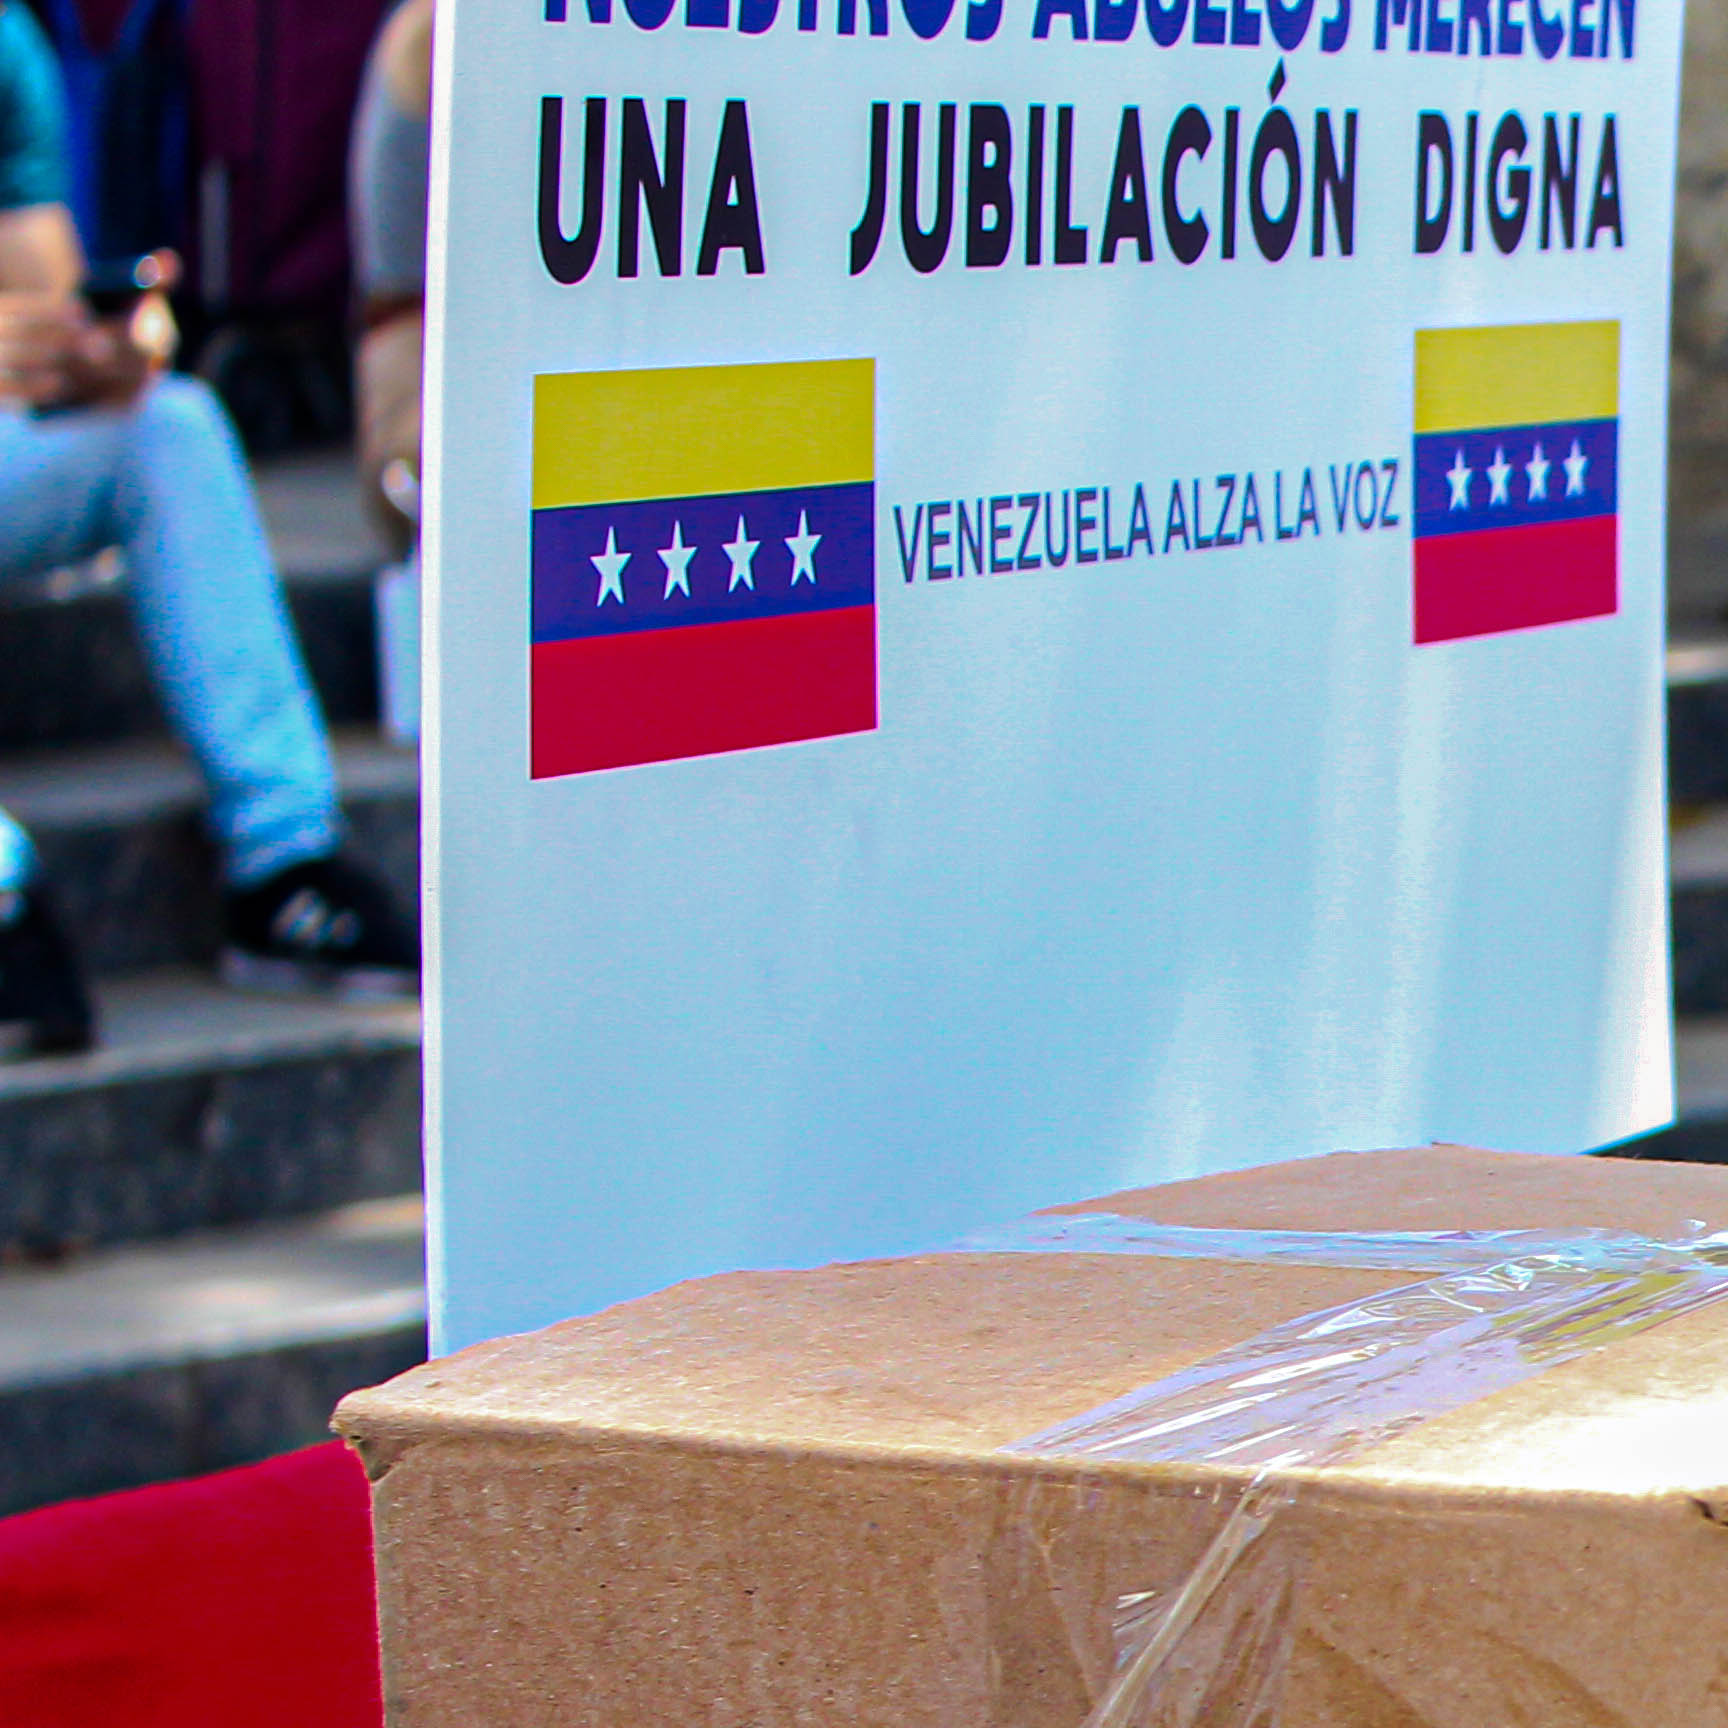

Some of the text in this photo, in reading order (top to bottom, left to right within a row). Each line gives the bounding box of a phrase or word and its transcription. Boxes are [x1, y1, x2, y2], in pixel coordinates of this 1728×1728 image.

[537, 56, 1624, 285] UNA JUBILACIÓN DIGNA
[893, 457, 1400, 584] VENEZUELA ALZA LA VOZ
